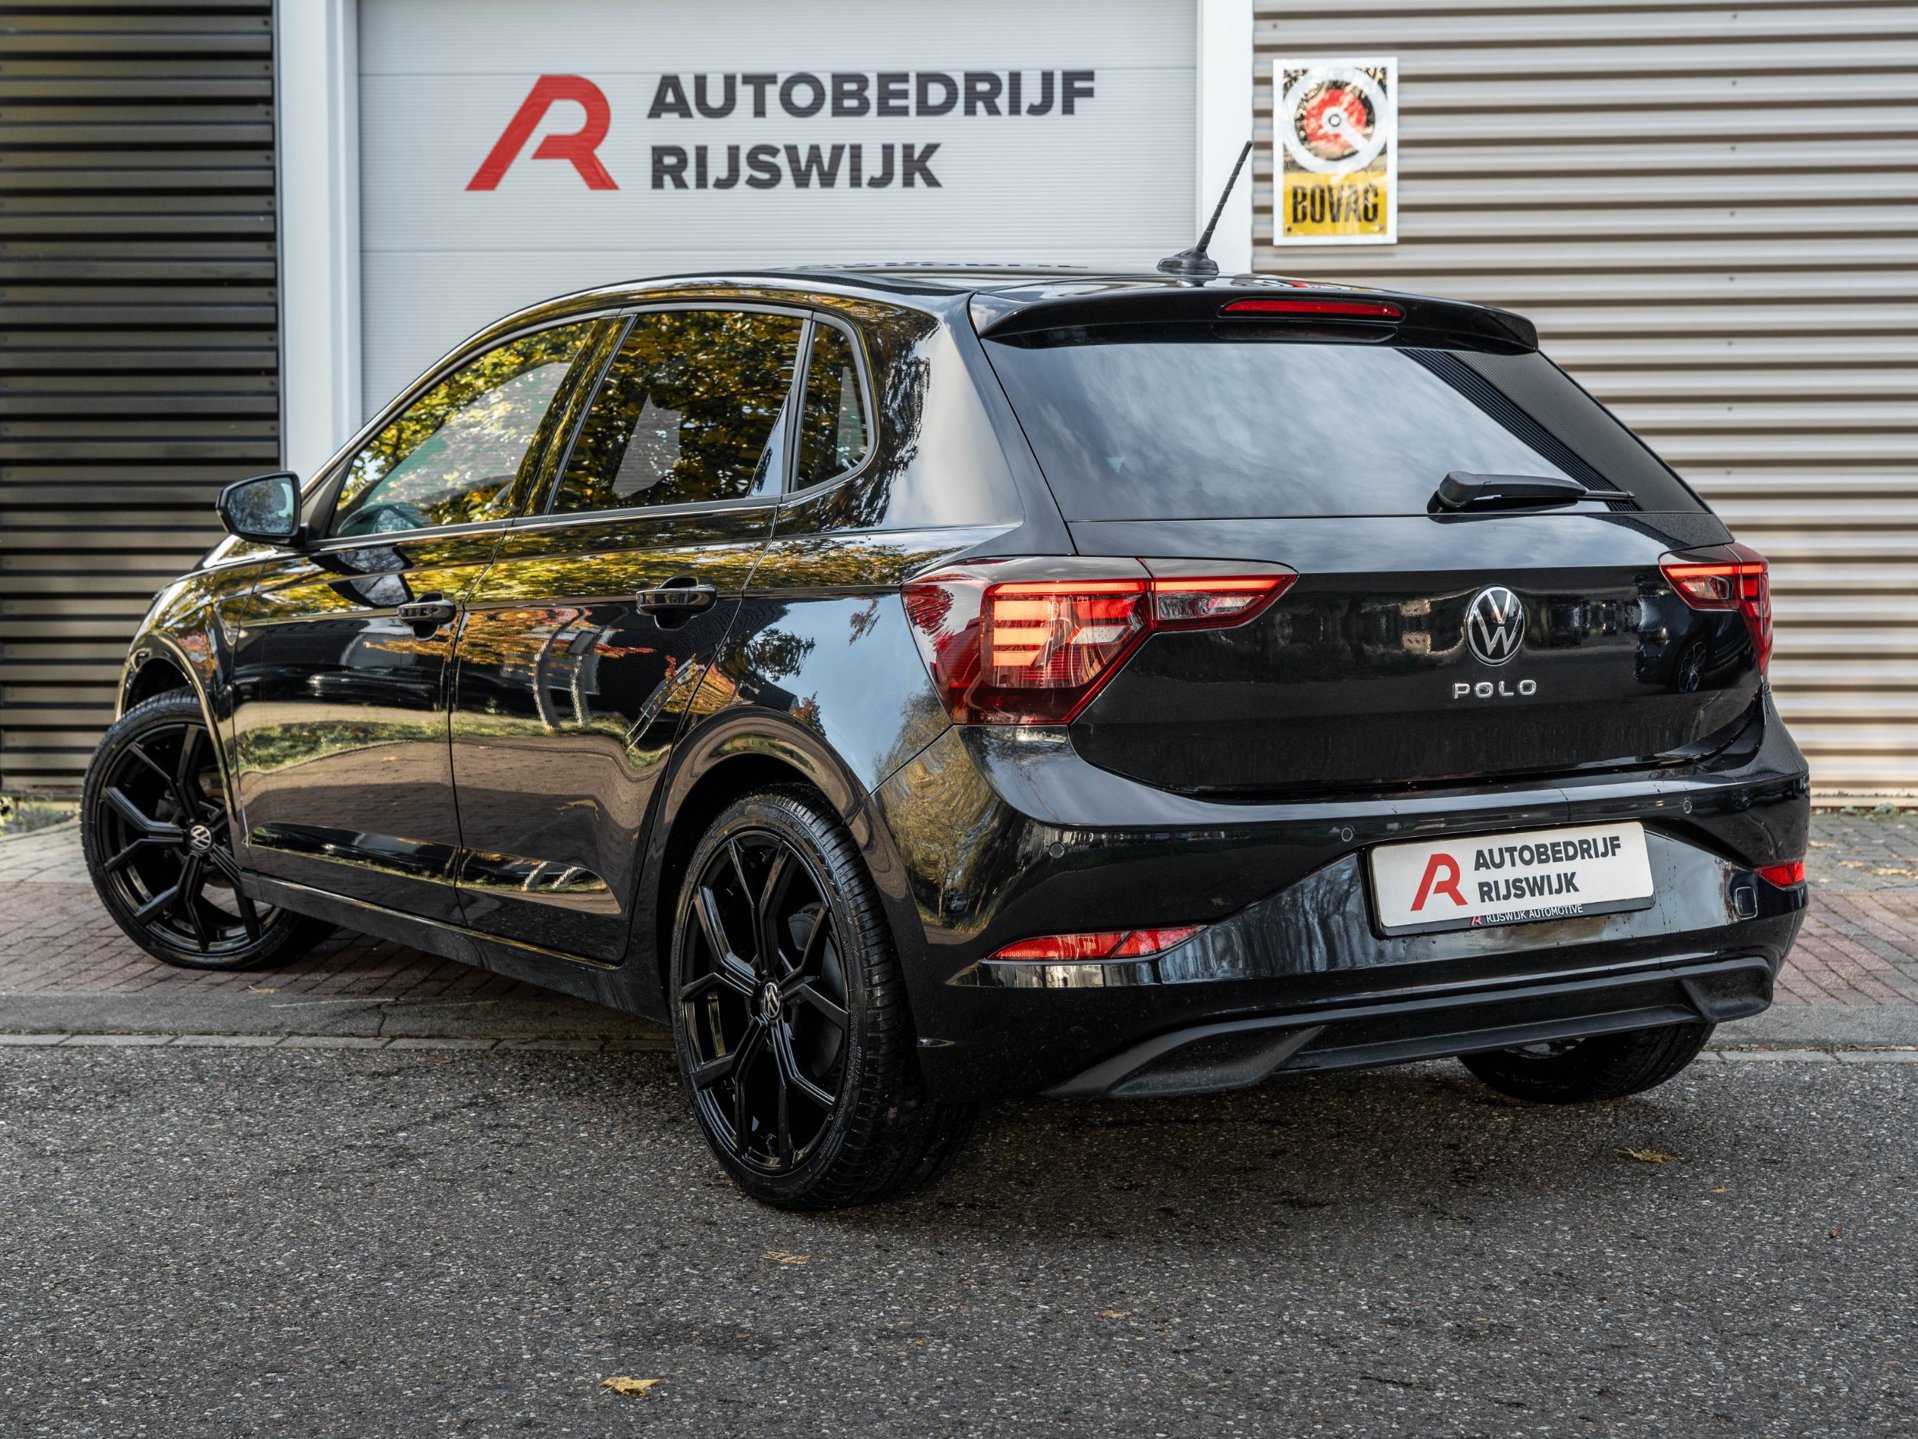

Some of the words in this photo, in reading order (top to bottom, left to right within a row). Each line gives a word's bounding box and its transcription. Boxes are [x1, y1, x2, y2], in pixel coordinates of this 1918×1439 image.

[647, 69, 1095, 119] AUTOBEDRIJF
[651, 143, 942, 190] RIJSWIJK
[1292, 184, 1379, 225] BOVAG
[1453, 679, 1537, 700] POLO
[1474, 836, 1622, 871] AUTOBEDRIJF
[1478, 872, 1580, 903] RIJSWIJK
[1486, 910, 1527, 923] RIJSWIJK
[1529, 904, 1583, 918] AUTOMOTIVE
